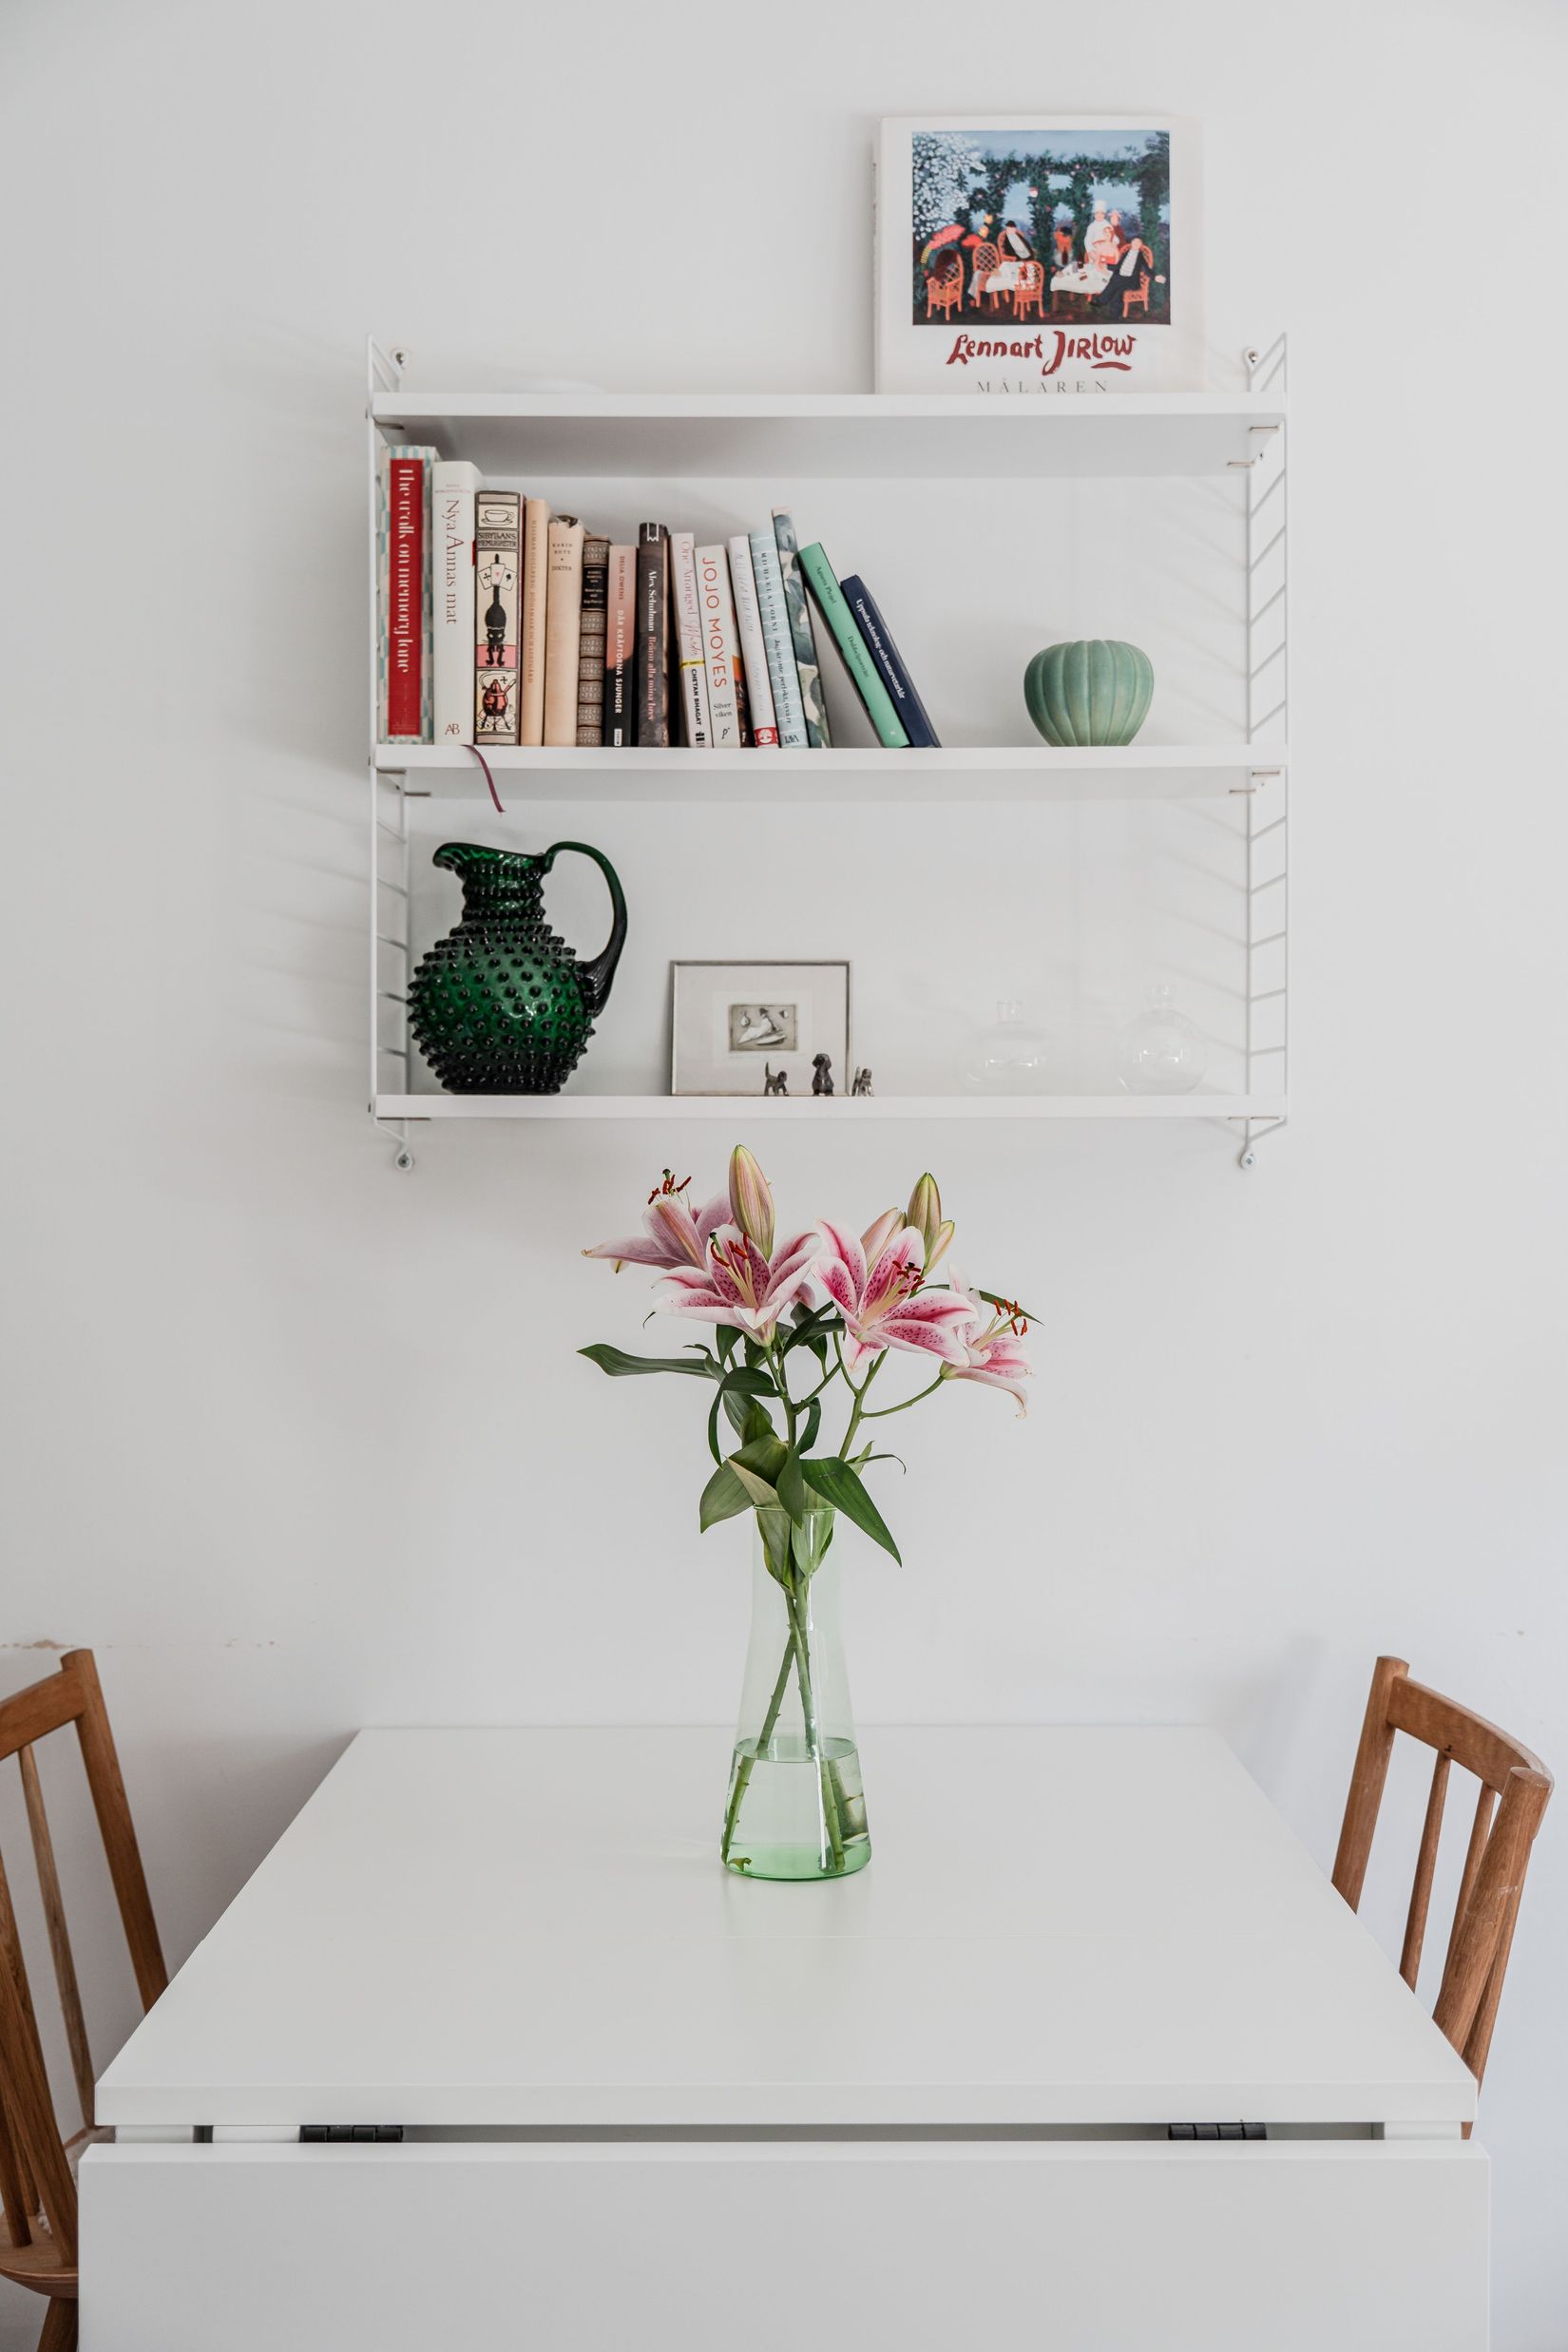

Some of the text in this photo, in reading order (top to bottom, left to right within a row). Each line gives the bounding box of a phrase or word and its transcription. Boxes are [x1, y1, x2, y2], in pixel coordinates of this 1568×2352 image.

[947, 330, 1137, 375] Lennart JIRLOW
[977, 377, 1108, 393] MÅLAREN
[441, 500, 460, 530] Nya
[393, 469, 415, 673] The walk on memory lane
[446, 534, 465, 587] Annas
[446, 593, 457, 624] mat
[648, 570, 658, 632] Alex Schulman
[684, 569, 698, 615] Arranged
[702, 557, 727, 688] JOJO MOYES
[856, 598, 870, 623] Uppsala
[878, 647, 889, 660] och
[647, 664, 658, 682] alla
[614, 678, 623, 713] SJUNGER
[647, 683, 657, 701] mina
[691, 668, 702, 725] CHETAN BHAGAT
[713, 702, 732, 711] Silver
[445, 723, 461, 736] AB
[647, 703, 657, 721] brev
